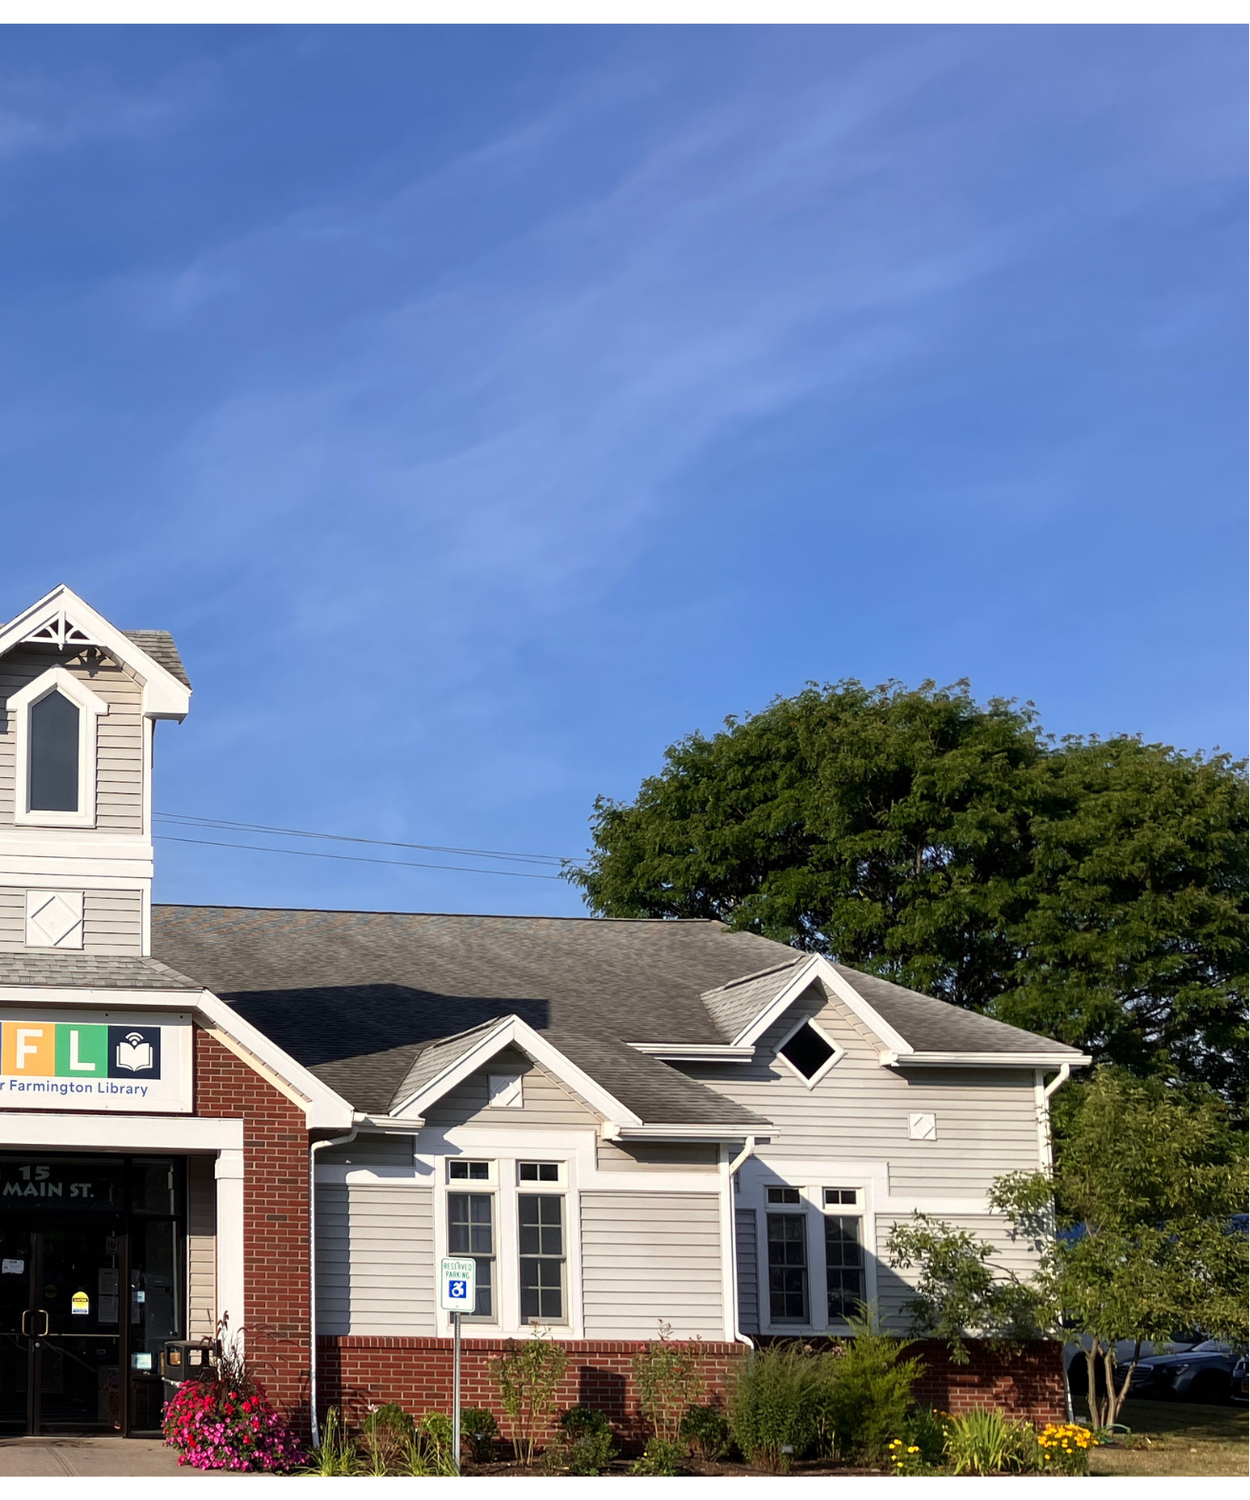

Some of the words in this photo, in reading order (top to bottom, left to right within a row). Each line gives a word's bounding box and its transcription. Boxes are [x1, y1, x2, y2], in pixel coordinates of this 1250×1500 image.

[9, 1079, 93, 1095] Farmington
[98, 1082, 149, 1097] Library
[18, 1165, 50, 1180] 15
[2, 1181, 64, 1197] MAIN
[69, 1182, 95, 1198] ST.
[443, 1262, 472, 1271] RESERVED
[446, 1271, 469, 1279] PARKNG
